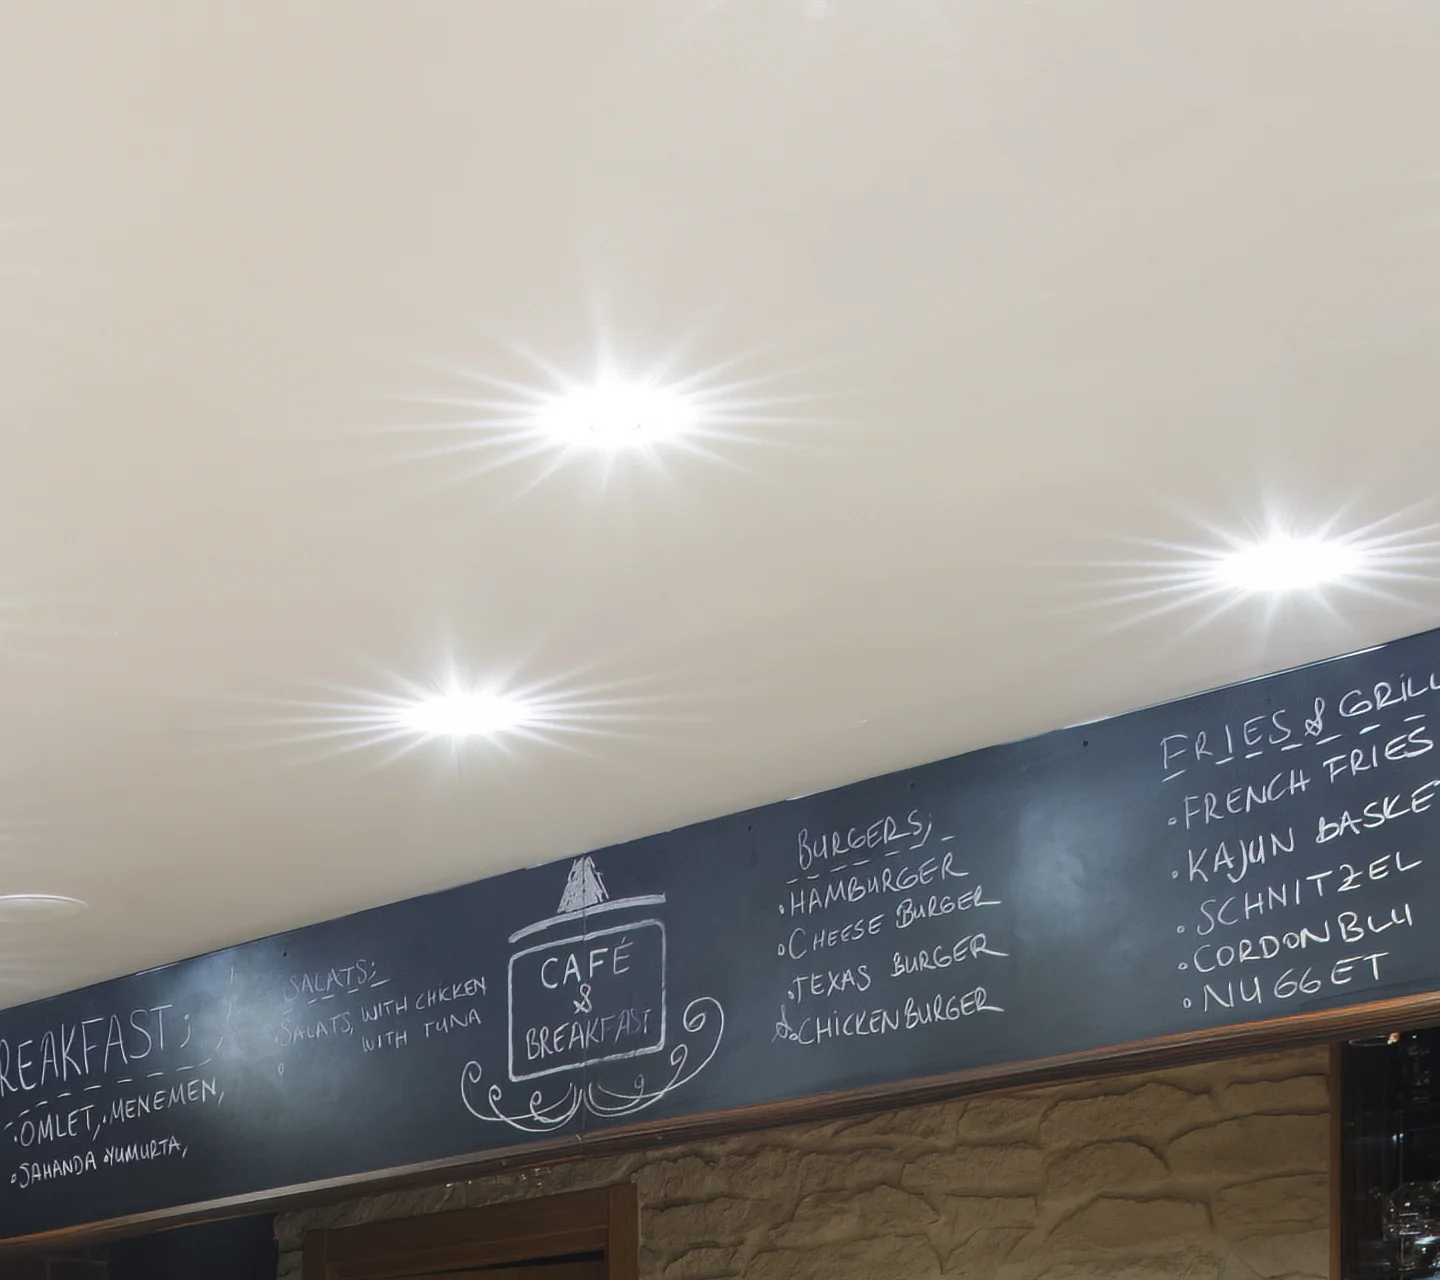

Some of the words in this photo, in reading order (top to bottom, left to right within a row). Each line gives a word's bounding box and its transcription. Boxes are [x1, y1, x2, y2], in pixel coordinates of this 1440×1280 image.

[1160, 709, 1292, 770] FRIES
[1183, 769, 1311, 829] FRENCH
[1322, 726, 1434, 784] FRIES
[790, 852, 969, 916] HAMBURGER
[1188, 827, 1294, 884] KAJUN
[787, 913, 885, 960] CHEESE
[895, 886, 1002, 930] BURGER
[1196, 851, 1423, 937] SCHNITZEL
[540, 936, 635, 989] CAFÉ
[793, 964, 872, 1003] TEXAS
[890, 932, 1010, 978] BURGER
[360, 996, 408, 1024] WITH
[415, 975, 487, 1011] CHICKEN
[361, 1030, 408, 1053] WITH
[423, 1009, 482, 1039] TUNA
[525, 1008, 653, 1061] BREAKFAST
[19, 1151, 97, 1189] SAHANDA
